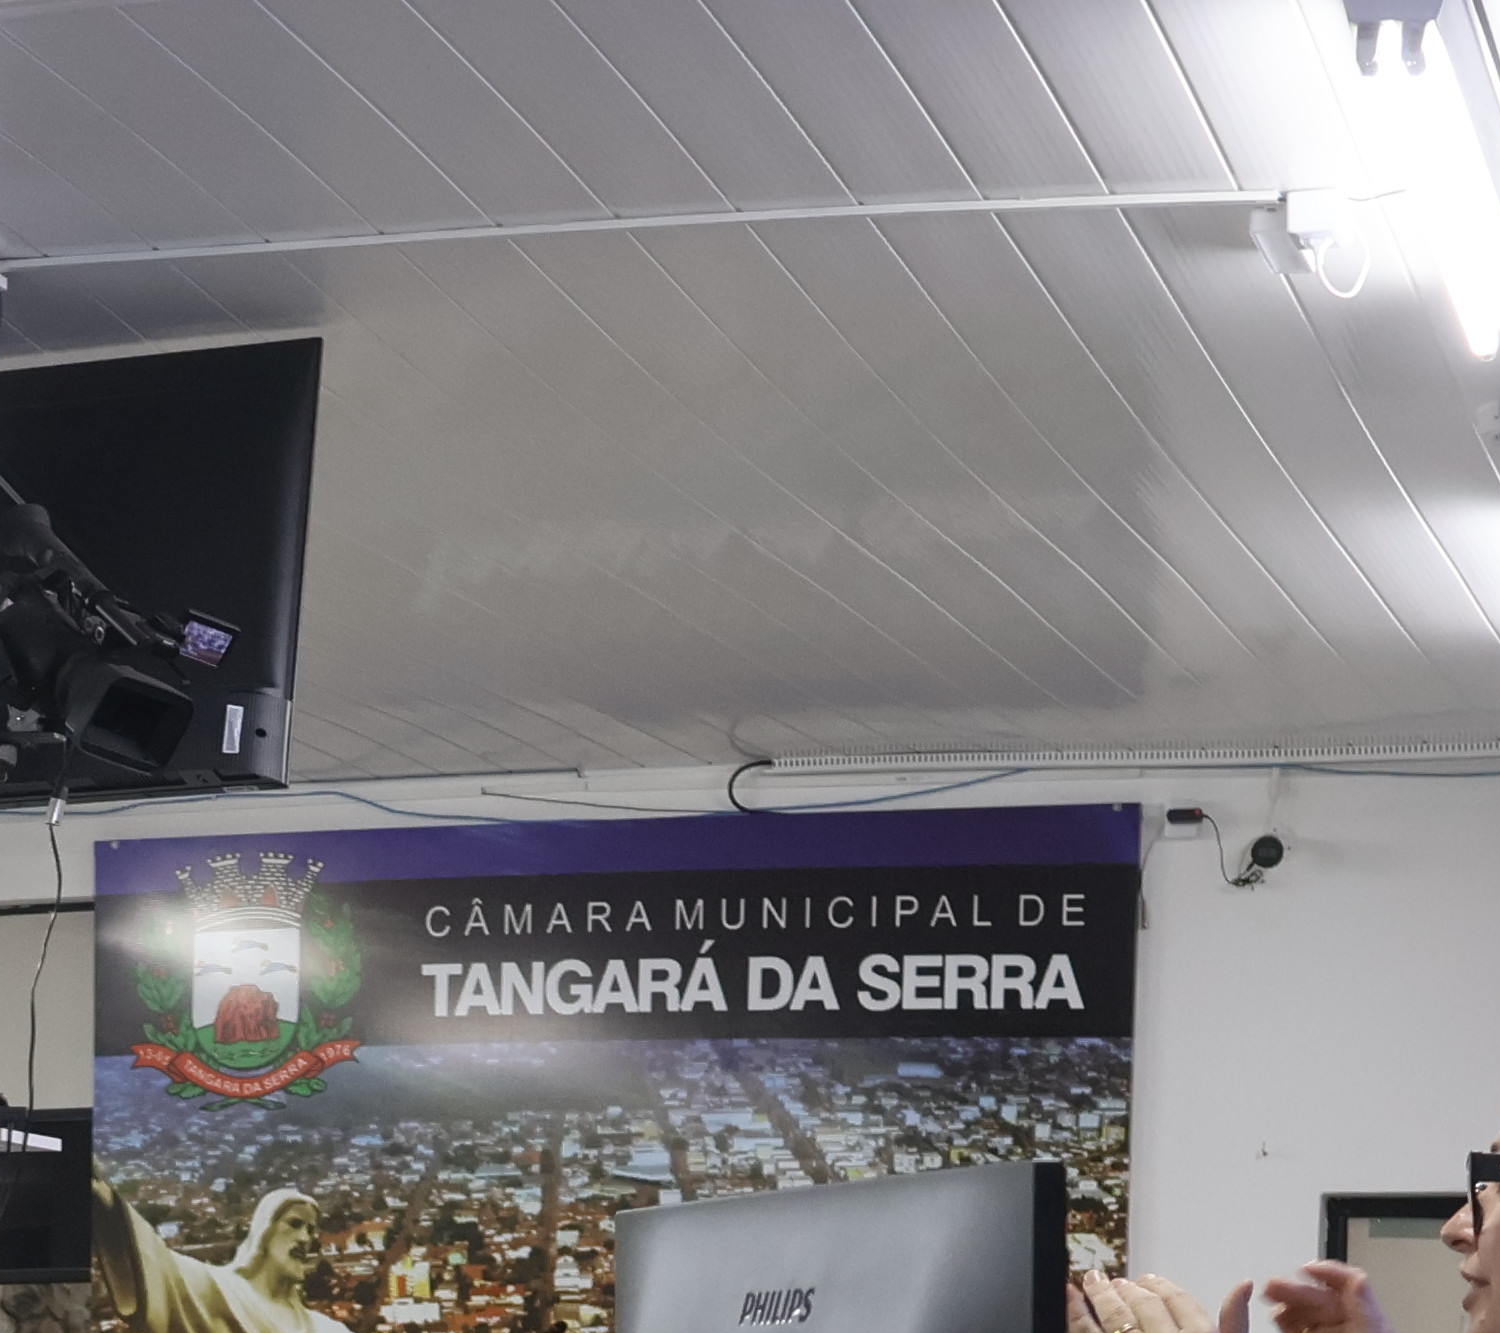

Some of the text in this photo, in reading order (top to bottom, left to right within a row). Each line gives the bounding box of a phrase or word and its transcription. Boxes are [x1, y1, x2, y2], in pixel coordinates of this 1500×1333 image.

[424, 894, 1085, 937] CÂMARA MUNICIPAL DE
[421, 940, 1085, 1016] TANGARÁ DA SERRA
[263, 1058, 308, 1089] SERRA
[739, 1287, 816, 1327] PHILIPS
